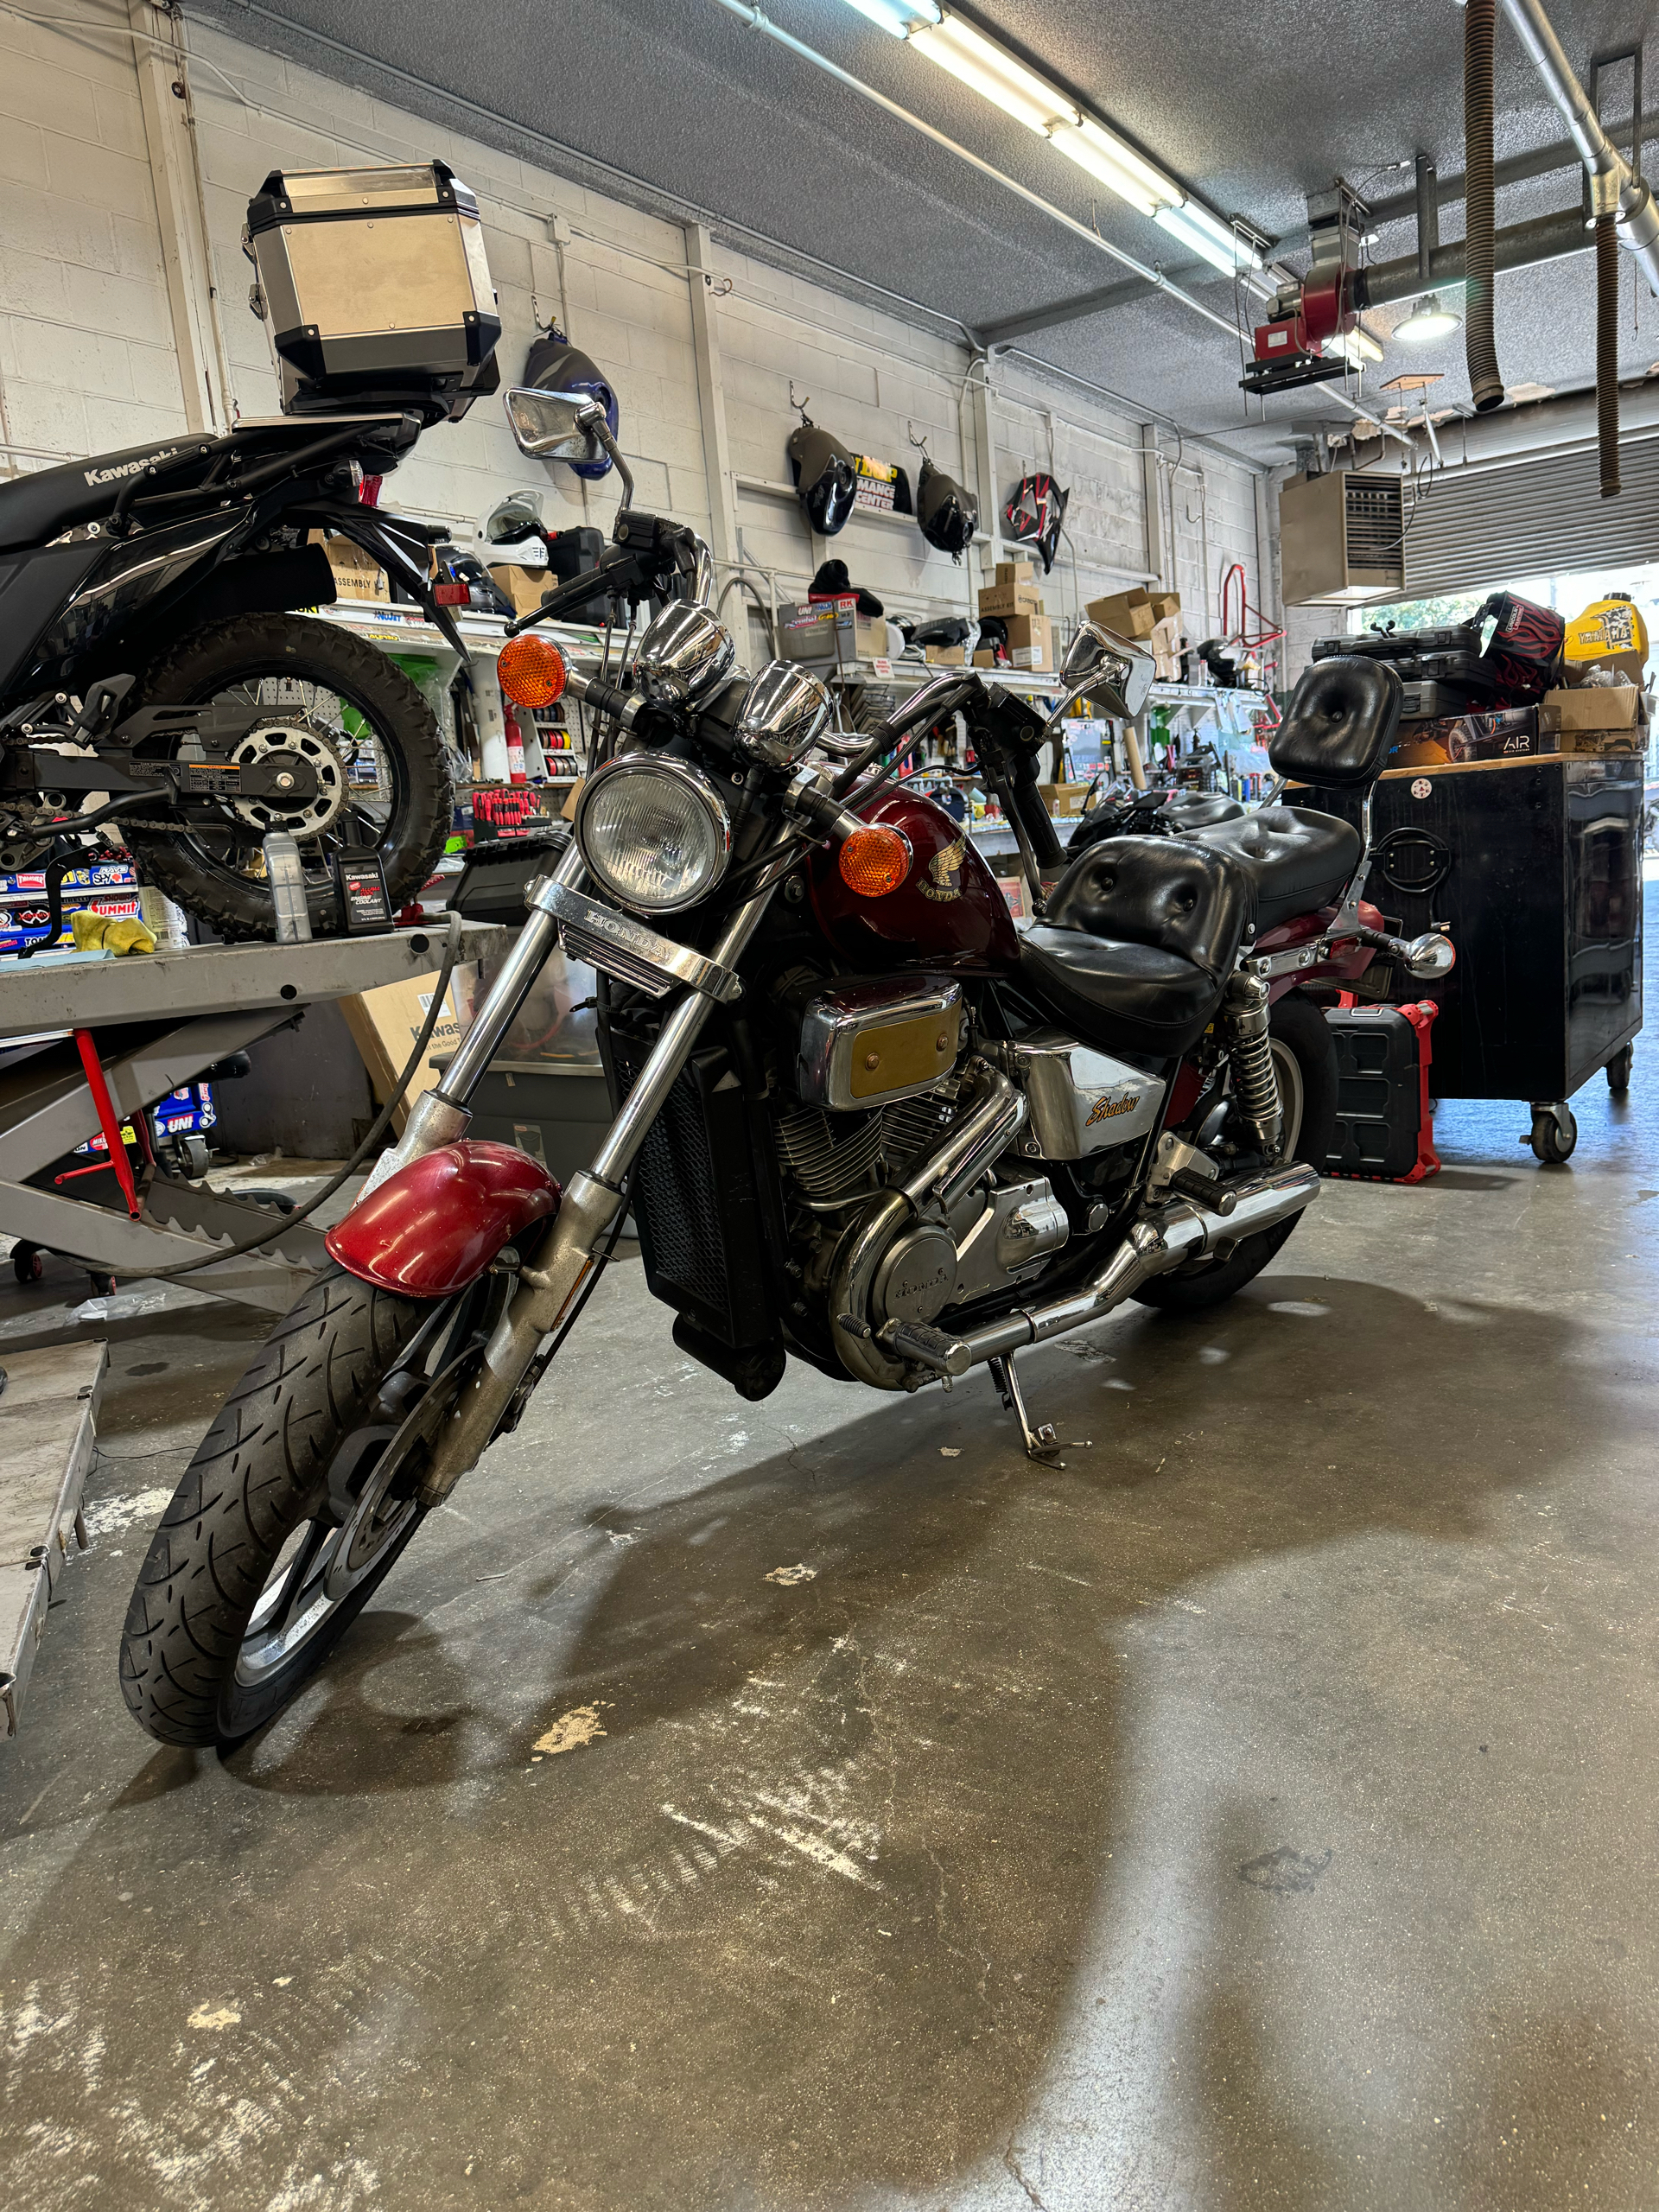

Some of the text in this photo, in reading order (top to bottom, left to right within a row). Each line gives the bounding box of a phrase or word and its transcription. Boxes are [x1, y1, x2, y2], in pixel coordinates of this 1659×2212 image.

[855, 491, 894, 511] CENTER
[334, 577, 371, 588] ASSEMBLY
[798, 606, 812, 615] UNI
[1507, 607, 1518, 631] LINCOLN
[1578, 626, 1628, 644] YAMAHA
[1503, 735, 1529, 750] AIR
[94, 874, 111, 883] SPY
[916, 877, 961, 902] HONDA
[584, 909, 668, 962] HONDA
[410, 1022, 461, 1042] Kwas
[442, 1039, 458, 1047] Good
[1085, 1092, 1140, 1126] Shadow
[168, 1116, 193, 1133] UNI
[894, 1274, 948, 1299] HONDA
